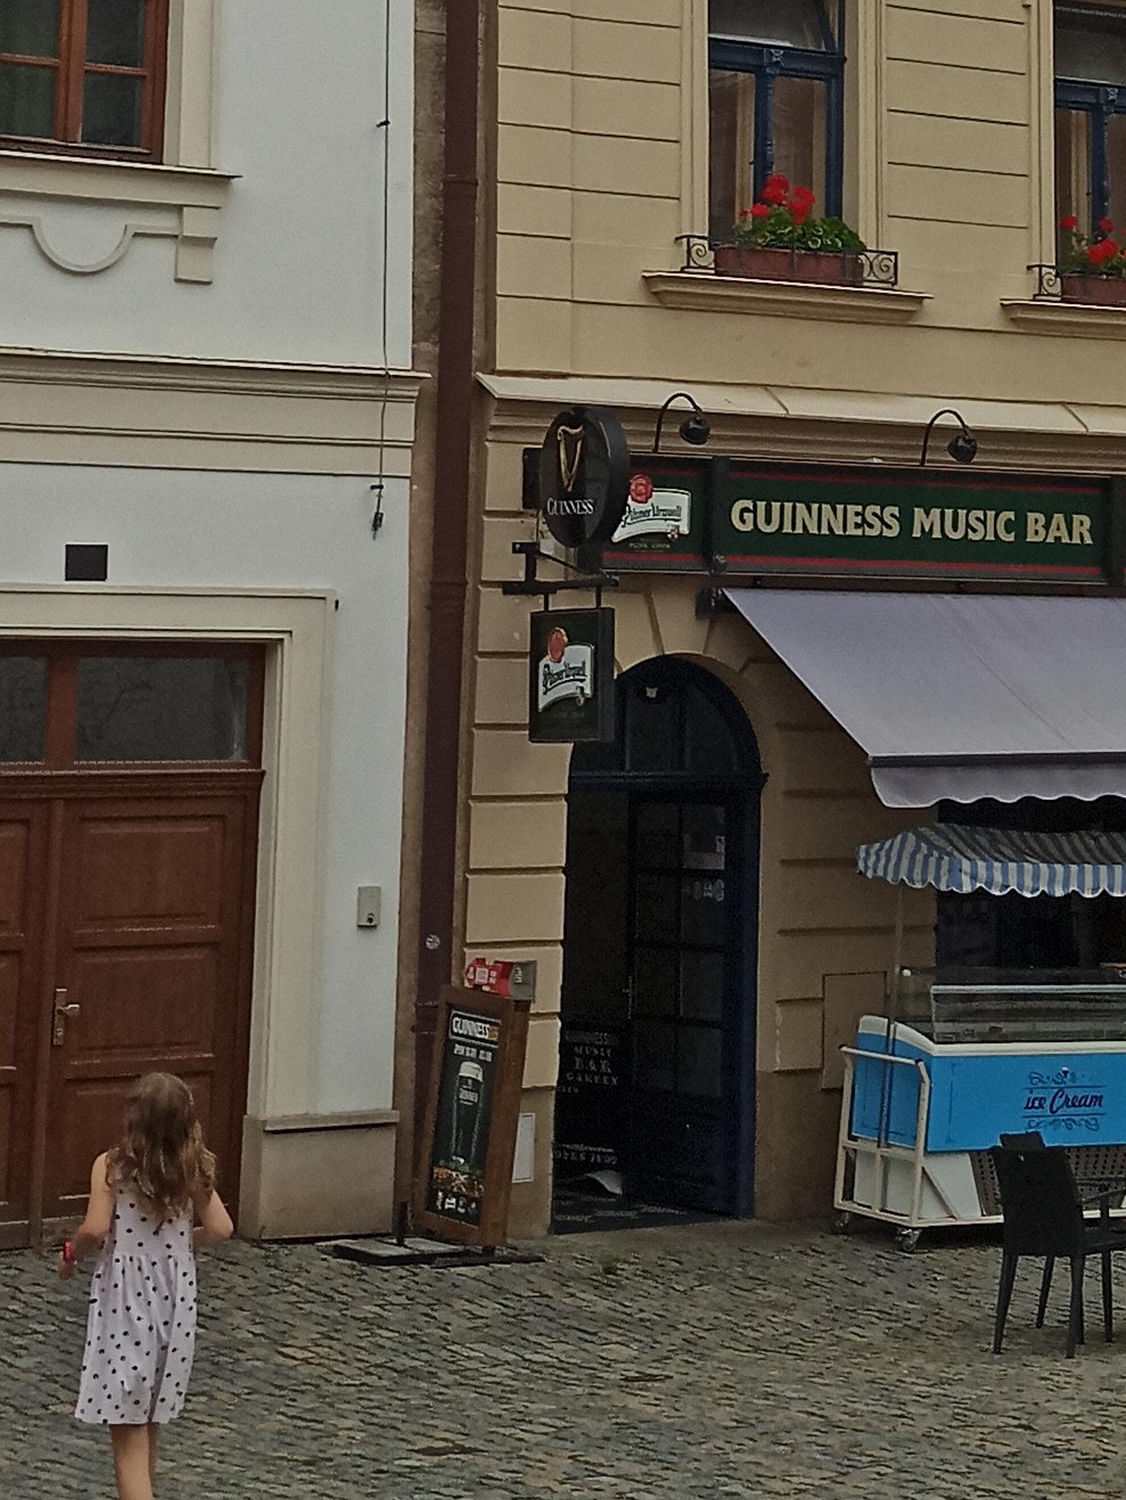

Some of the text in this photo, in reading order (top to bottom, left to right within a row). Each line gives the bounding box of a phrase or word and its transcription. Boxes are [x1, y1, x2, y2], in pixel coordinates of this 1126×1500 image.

[546, 497, 595, 516] GUINNESS
[729, 499, 1094, 546] GUINNESS MUSIC BAR
[1049, 1087, 1104, 1115] Cream
